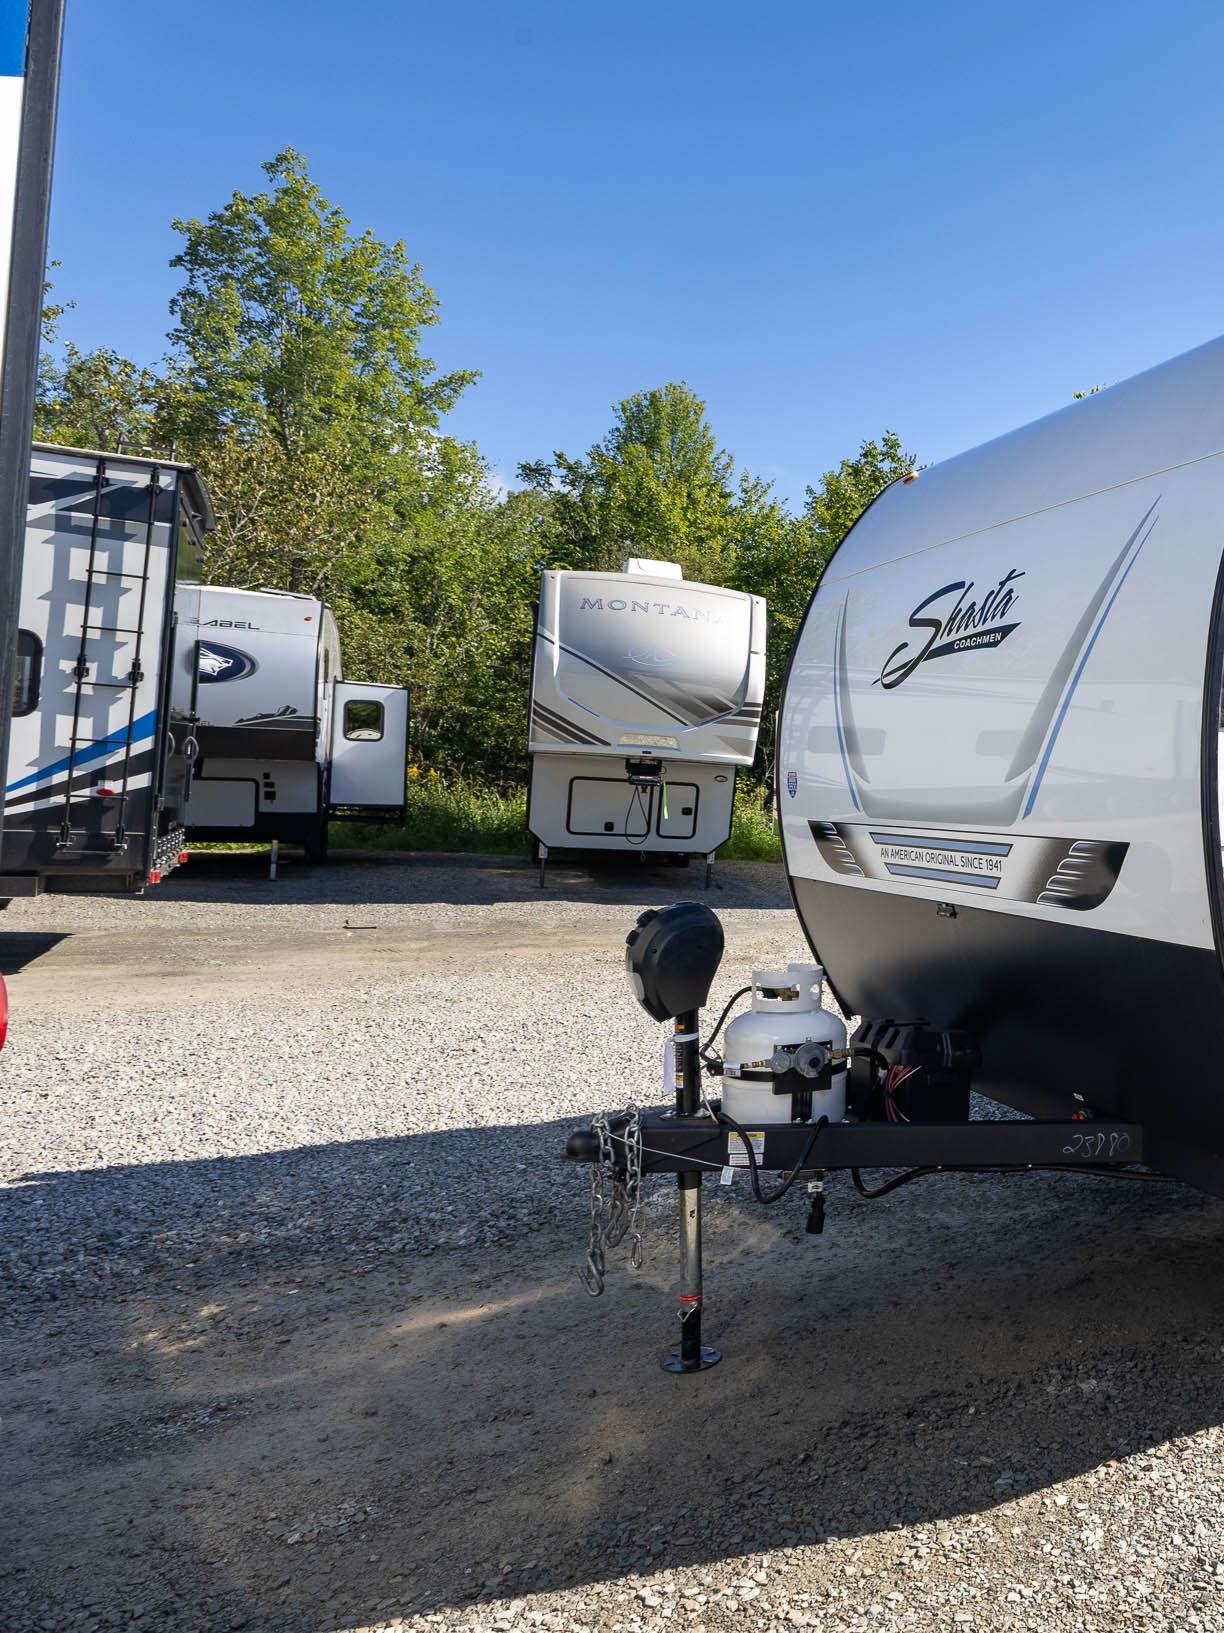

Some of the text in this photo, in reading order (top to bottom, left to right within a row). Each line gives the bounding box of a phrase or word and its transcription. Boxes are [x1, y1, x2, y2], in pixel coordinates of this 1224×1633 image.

[579, 597, 728, 624] MONTAN
[880, 568, 1026, 690] Shasta
[954, 632, 1002, 649] COACHMEN
[880, 848, 1002, 872] AN AMERICAN ORIGINAL SINCE 1941
